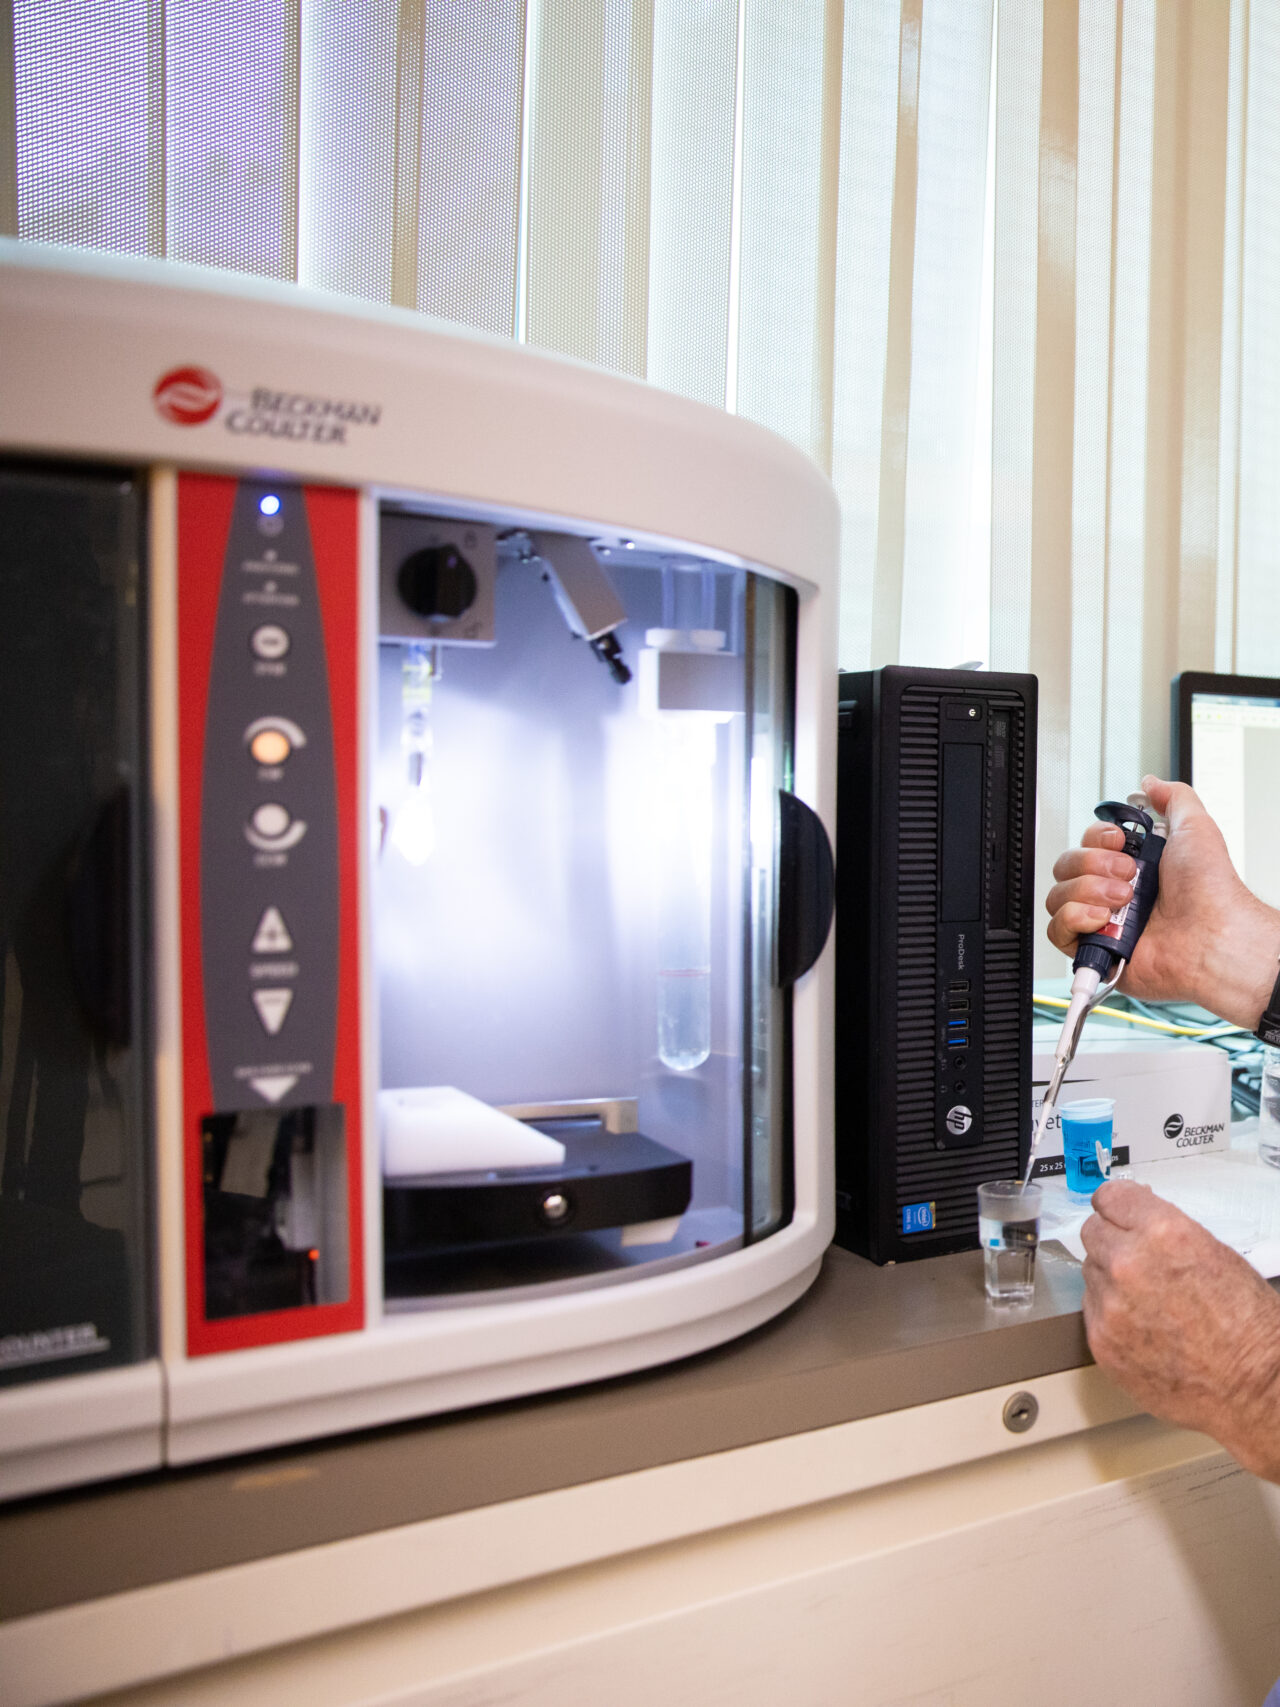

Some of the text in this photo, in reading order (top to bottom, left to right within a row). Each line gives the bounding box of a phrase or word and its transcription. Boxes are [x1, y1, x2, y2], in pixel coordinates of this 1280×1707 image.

[957, 934, 966, 970] ProDesk
[1184, 1122, 1225, 1137] BECKMAN
[1176, 1134, 1215, 1148] COULTER
[1040, 1164, 1049, 1172] 25
[1055, 1162, 1063, 1170] 25
